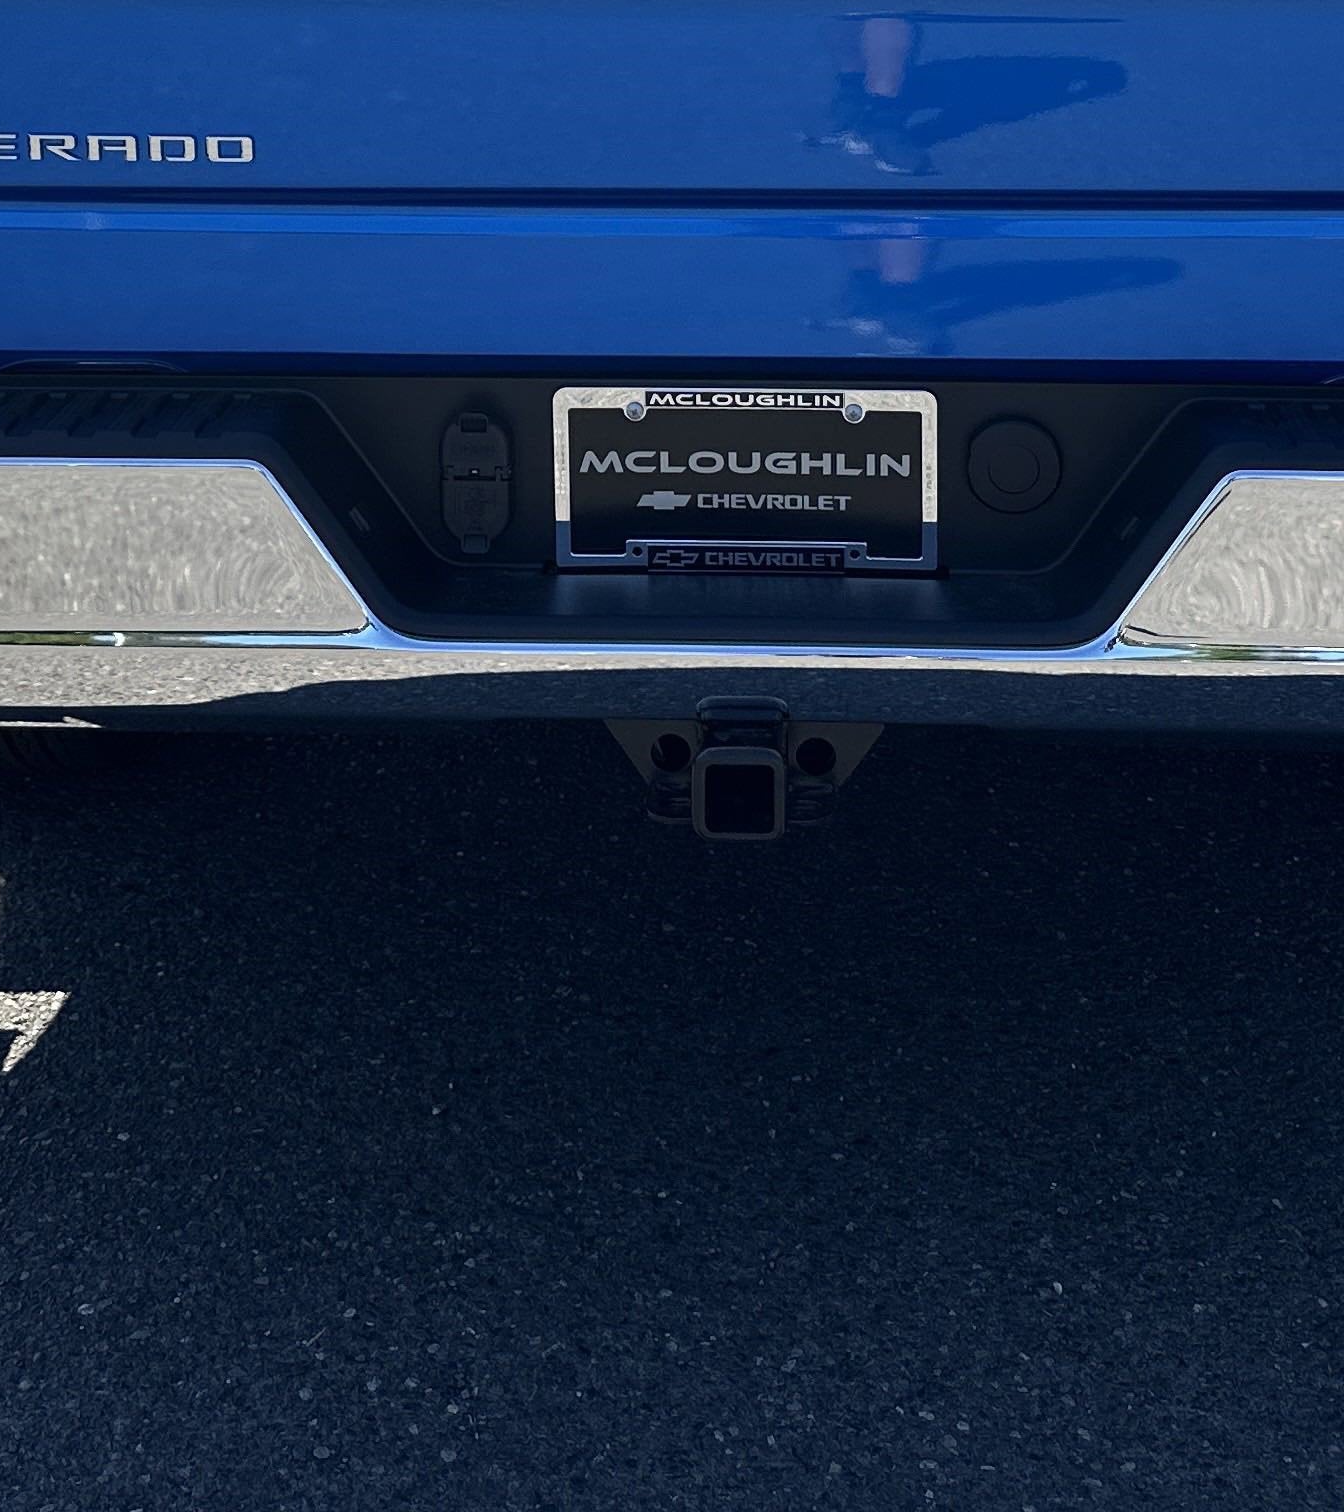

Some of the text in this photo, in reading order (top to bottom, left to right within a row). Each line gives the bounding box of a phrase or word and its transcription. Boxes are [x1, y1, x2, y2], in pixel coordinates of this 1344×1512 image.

[648, 392, 842, 407] MCLOUGHLIN
[578, 450, 911, 478] MCLOUGHLIN
[696, 493, 852, 511] CHEVROLET
[704, 550, 842, 568] CHEVROLET
